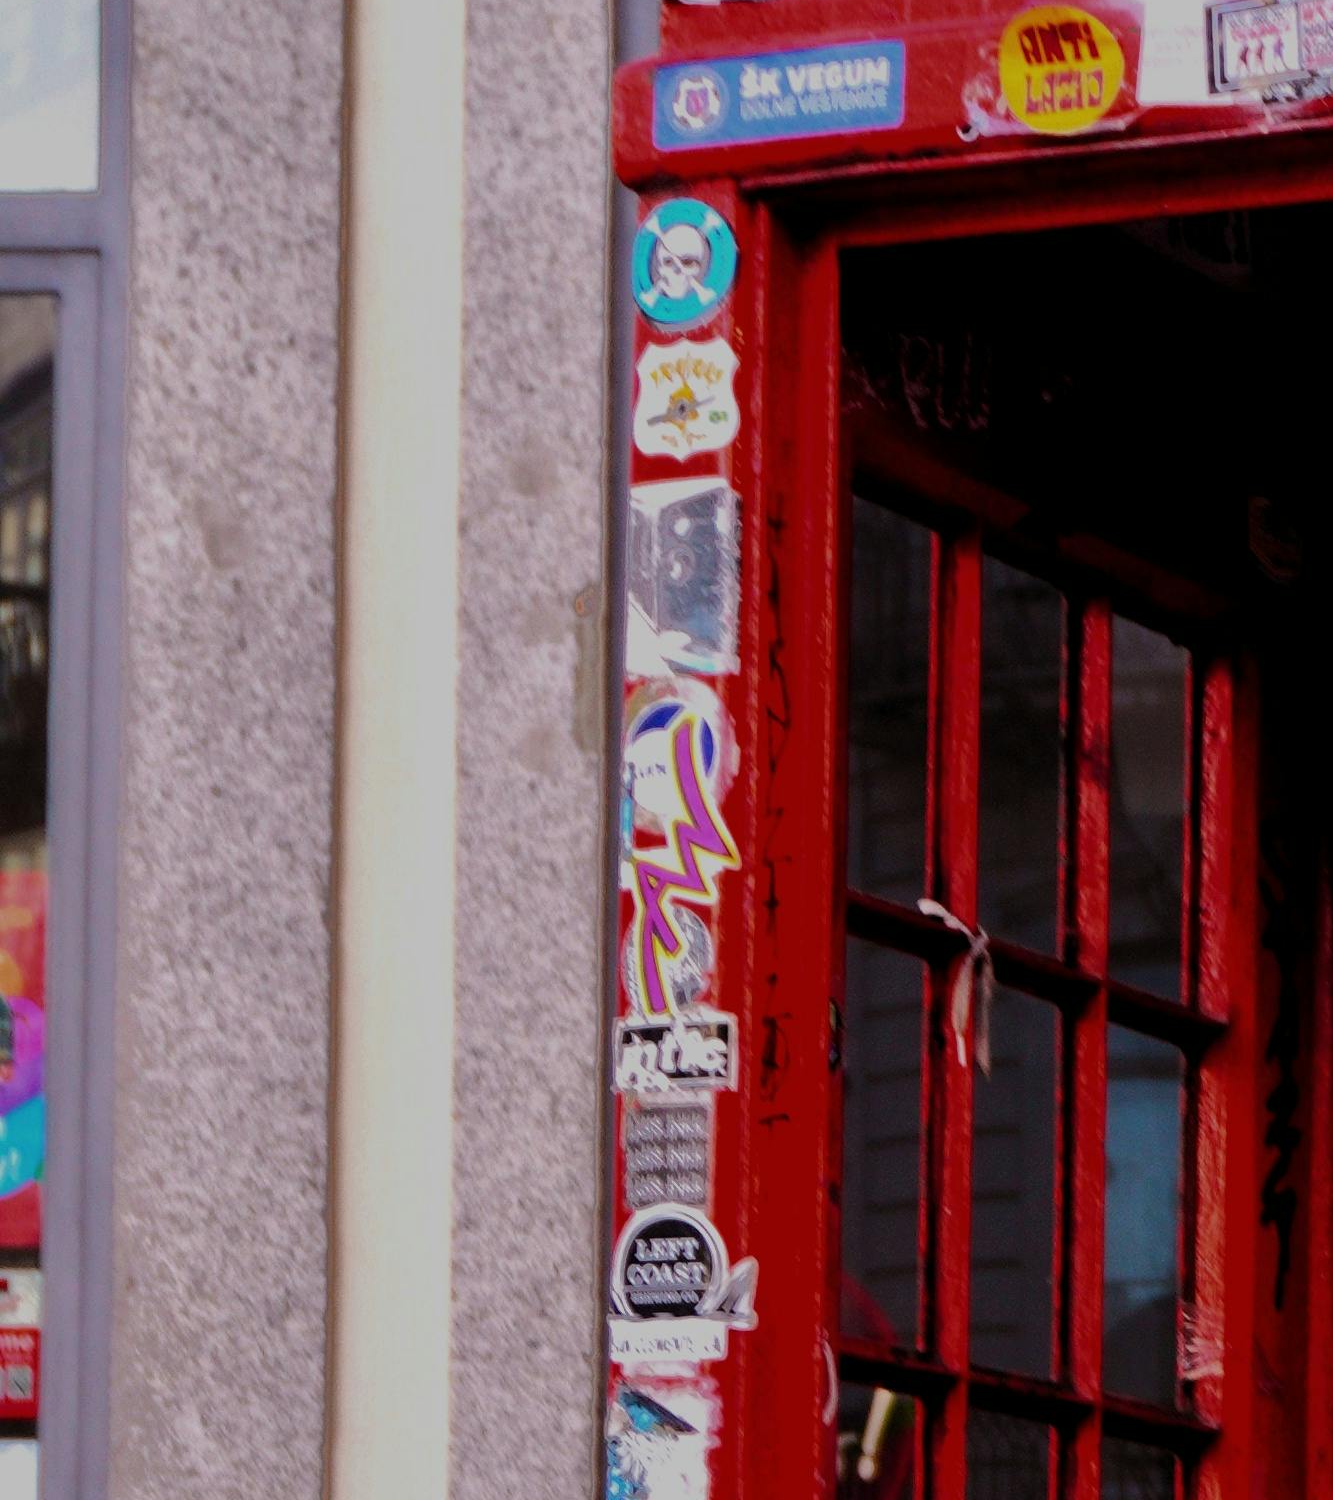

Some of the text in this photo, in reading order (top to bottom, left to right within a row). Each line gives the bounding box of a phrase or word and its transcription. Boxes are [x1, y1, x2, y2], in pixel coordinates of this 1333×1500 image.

[786, 55, 890, 94] VEGUM
[633, 1237, 700, 1262] LEFT
[626, 1261, 709, 1288] COAST
